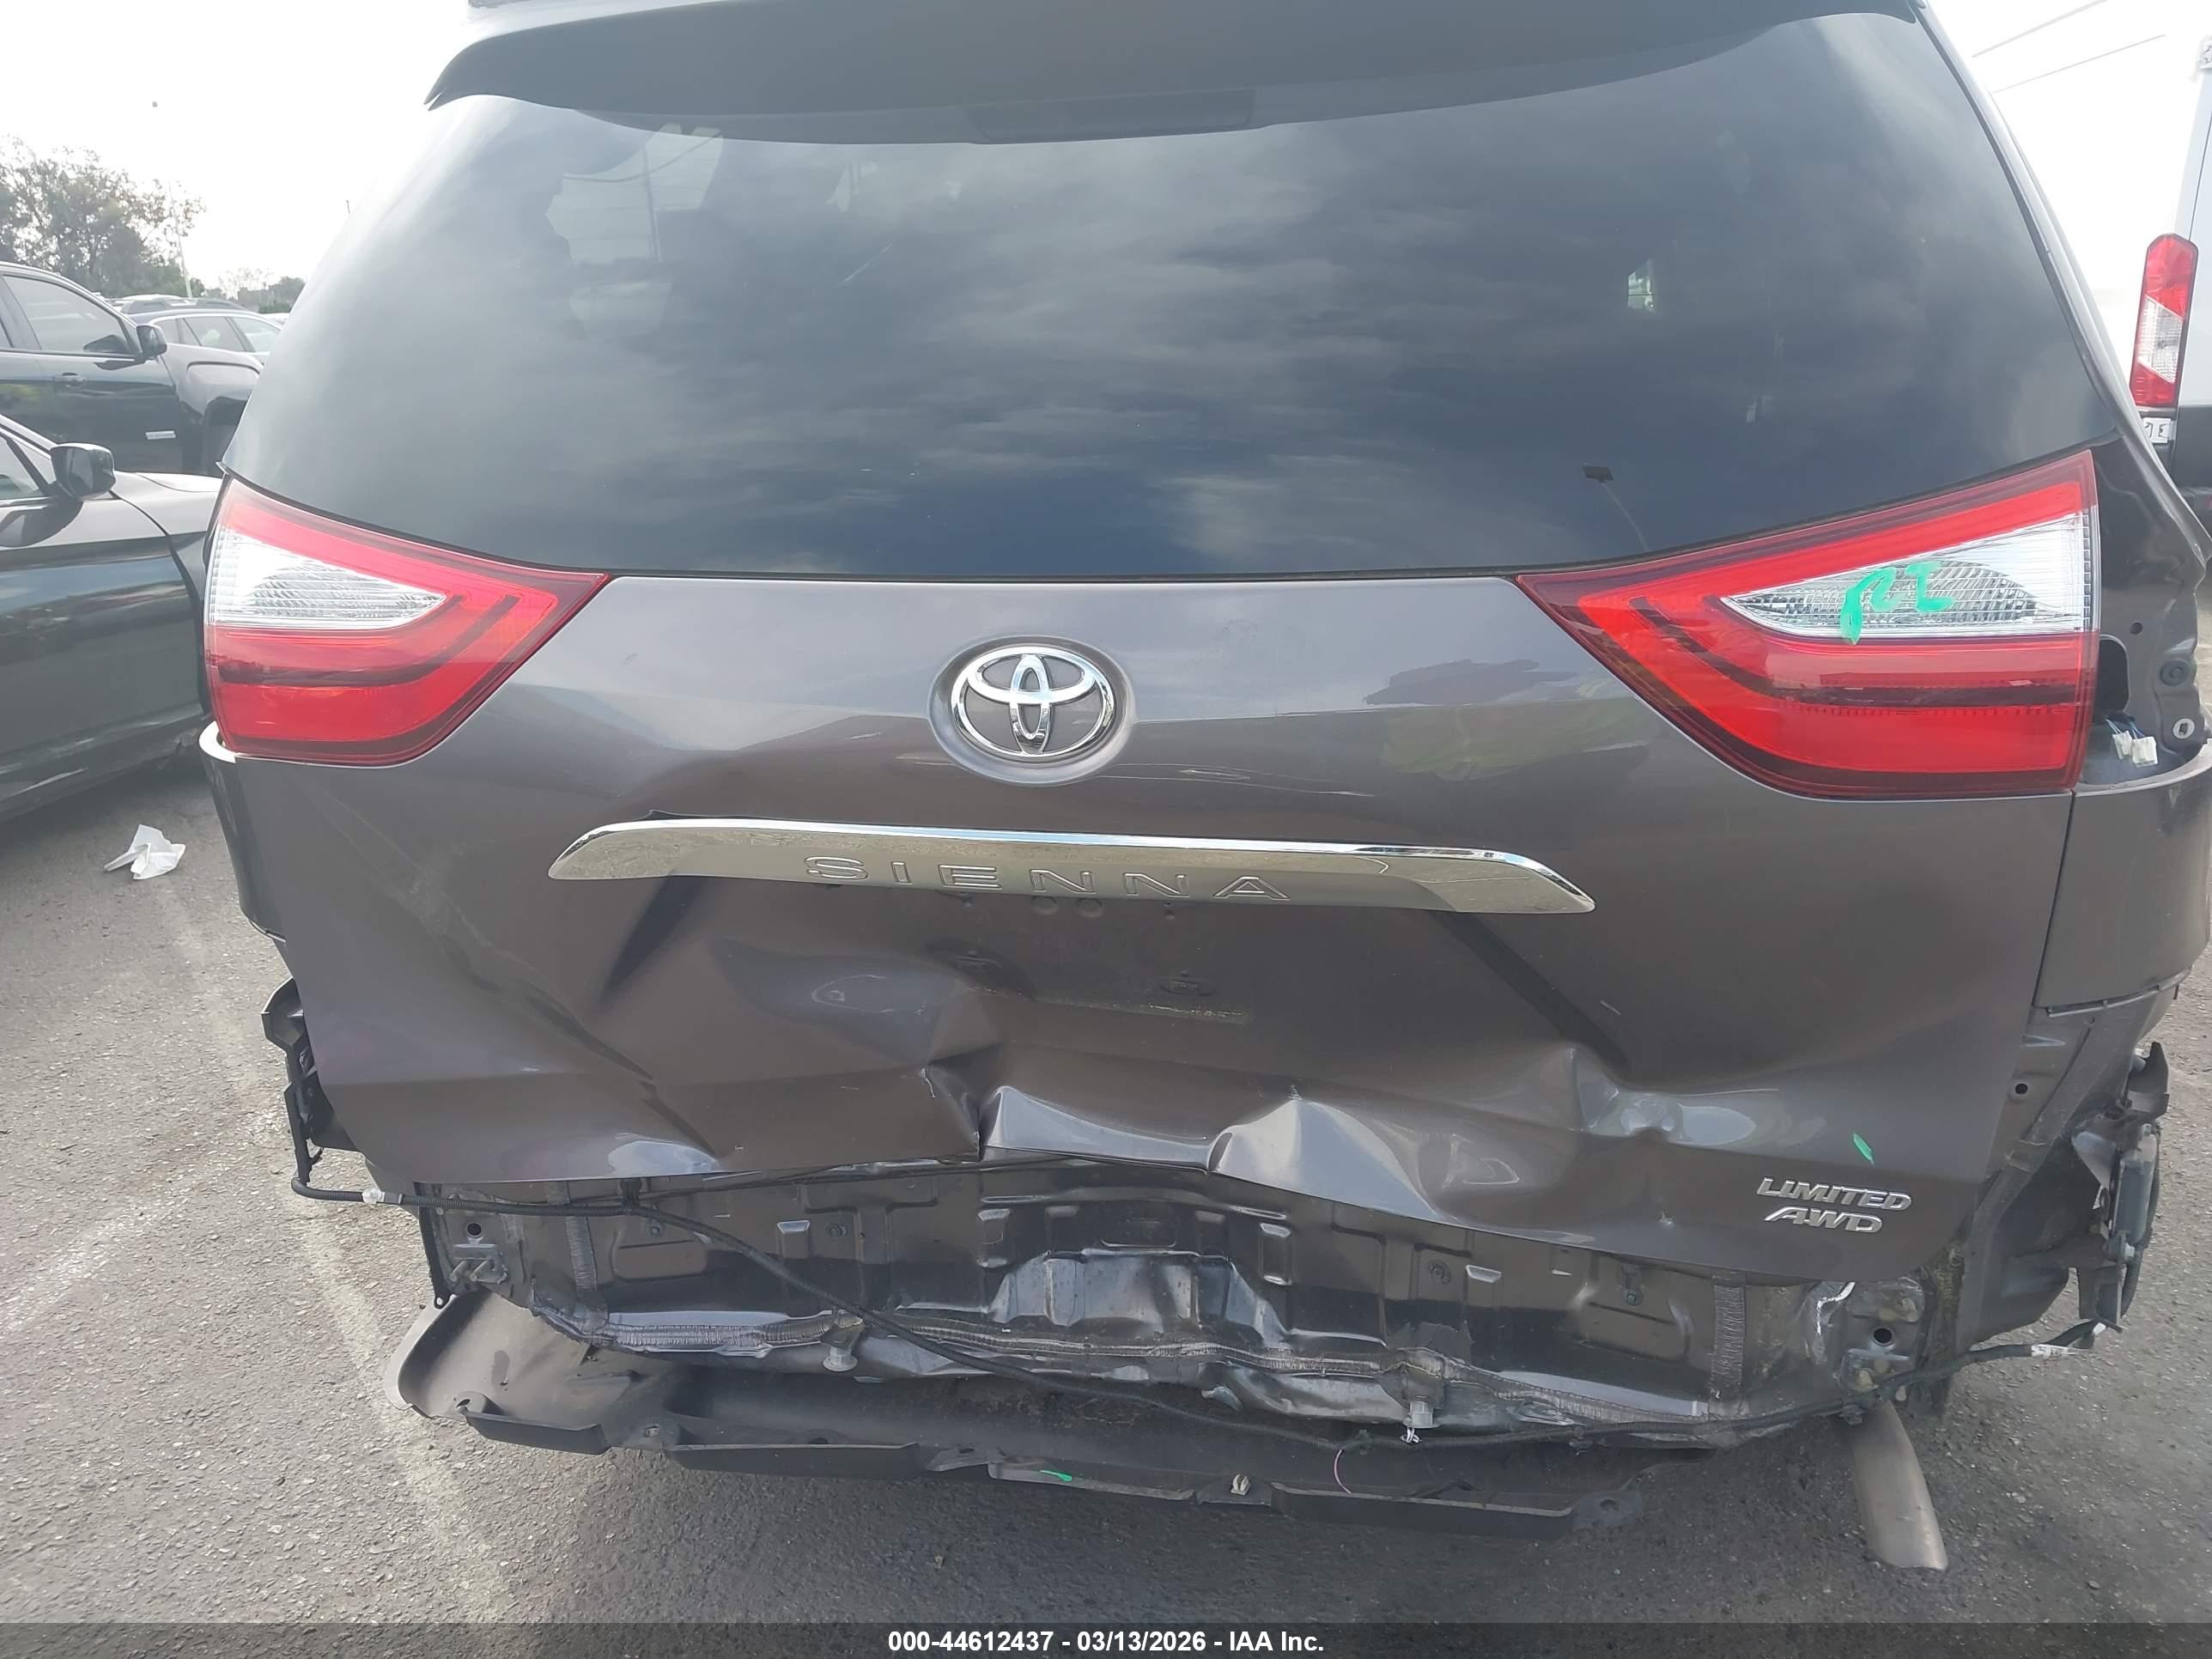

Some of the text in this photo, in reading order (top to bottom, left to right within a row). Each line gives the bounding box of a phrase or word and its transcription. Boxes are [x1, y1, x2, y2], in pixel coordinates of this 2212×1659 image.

[805, 856, 1291, 901] SIENNA
[1757, 1176, 1911, 1211] LIMITED
[1764, 1206, 1882, 1233] AWD
